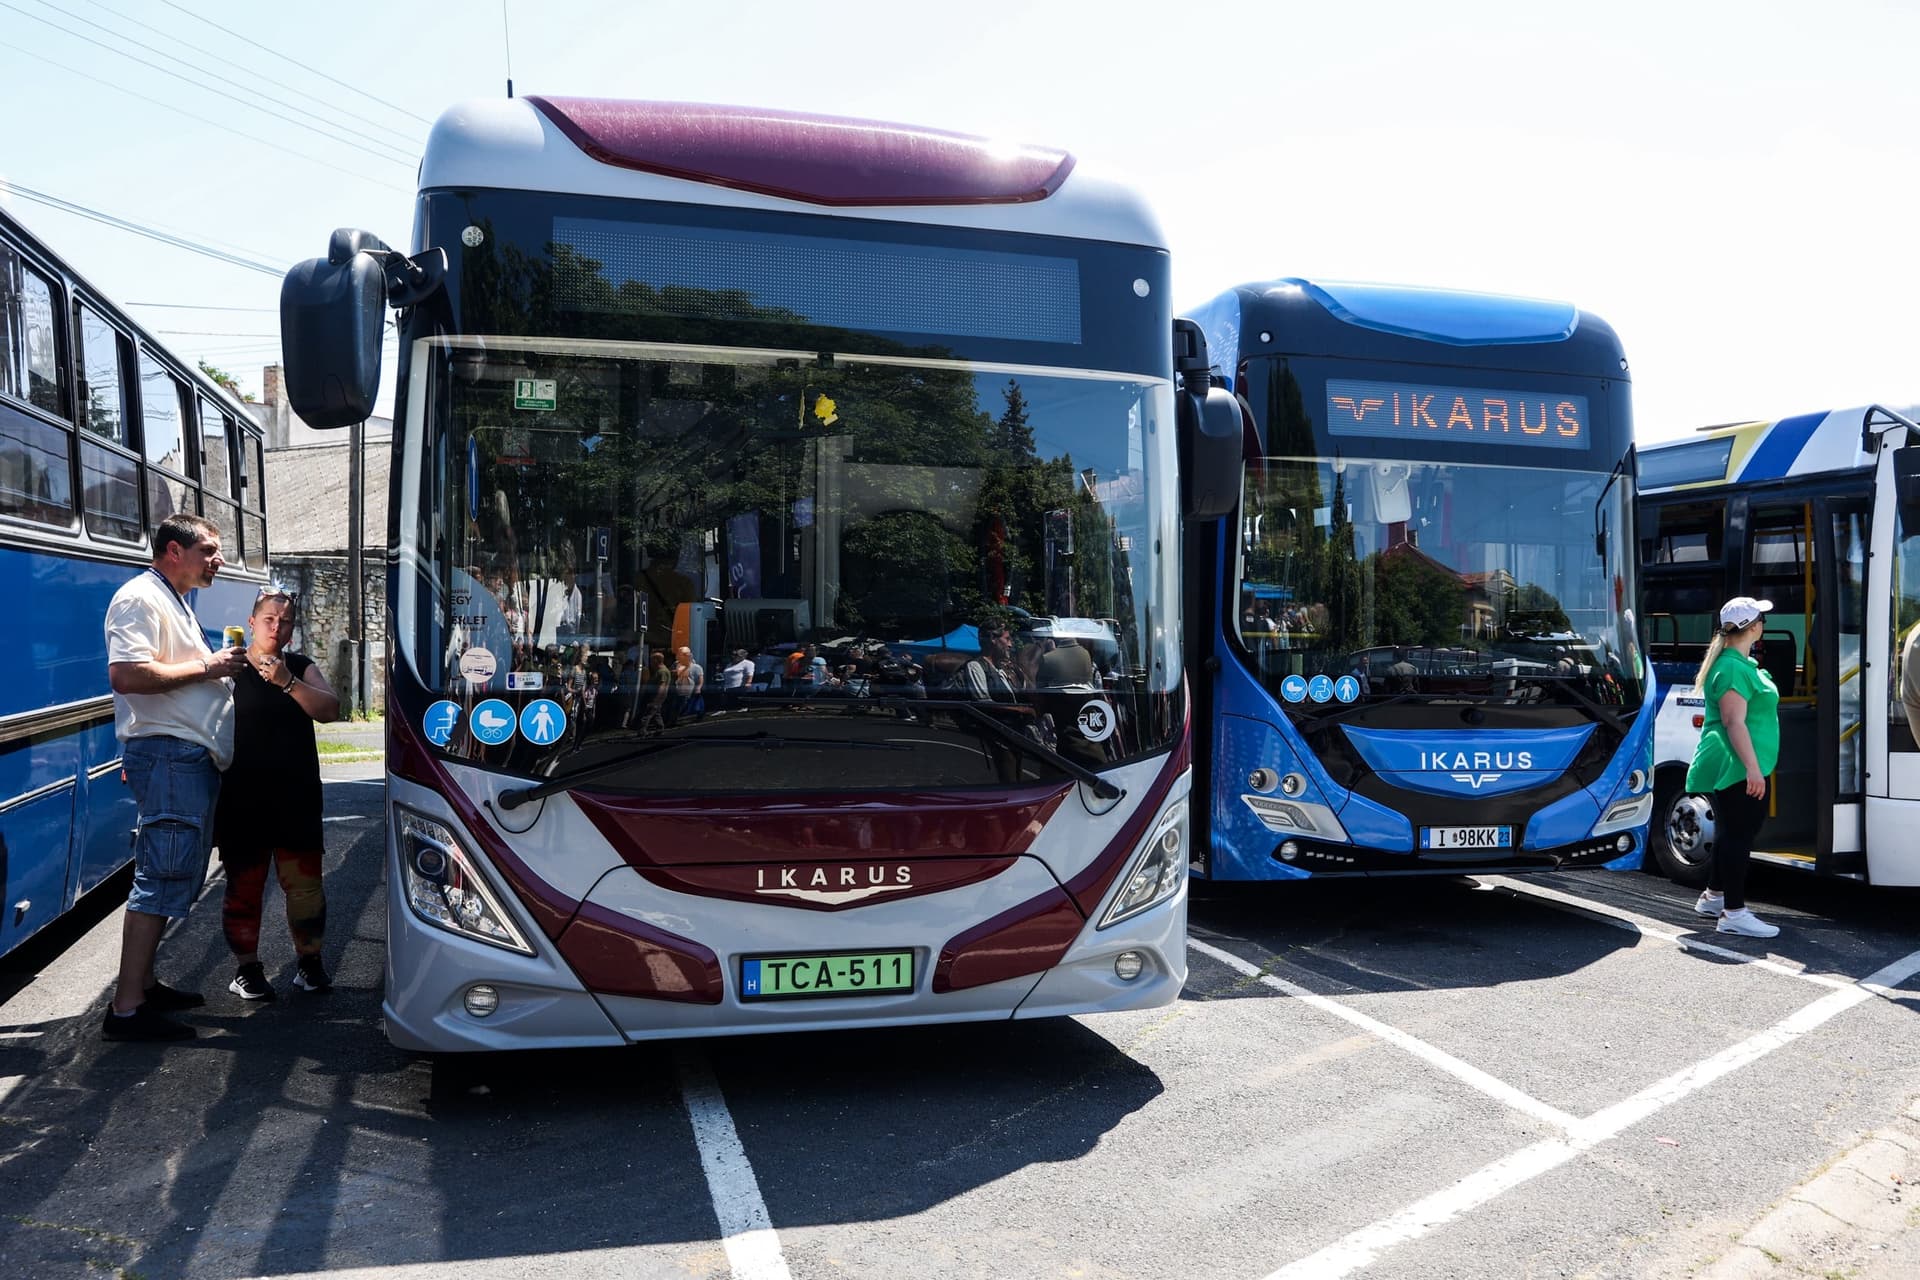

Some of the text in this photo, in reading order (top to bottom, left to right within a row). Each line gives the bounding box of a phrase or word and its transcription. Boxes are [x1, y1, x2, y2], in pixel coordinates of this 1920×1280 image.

[1393, 392, 1580, 437] IKARUS
[1421, 752, 1532, 770] IKARUS
[1459, 829, 1496, 847] 98KK
[1498, 831, 1510, 842] 23
[758, 866, 911, 888] IKARUS
[747, 957, 902, 991] H TCA-511
